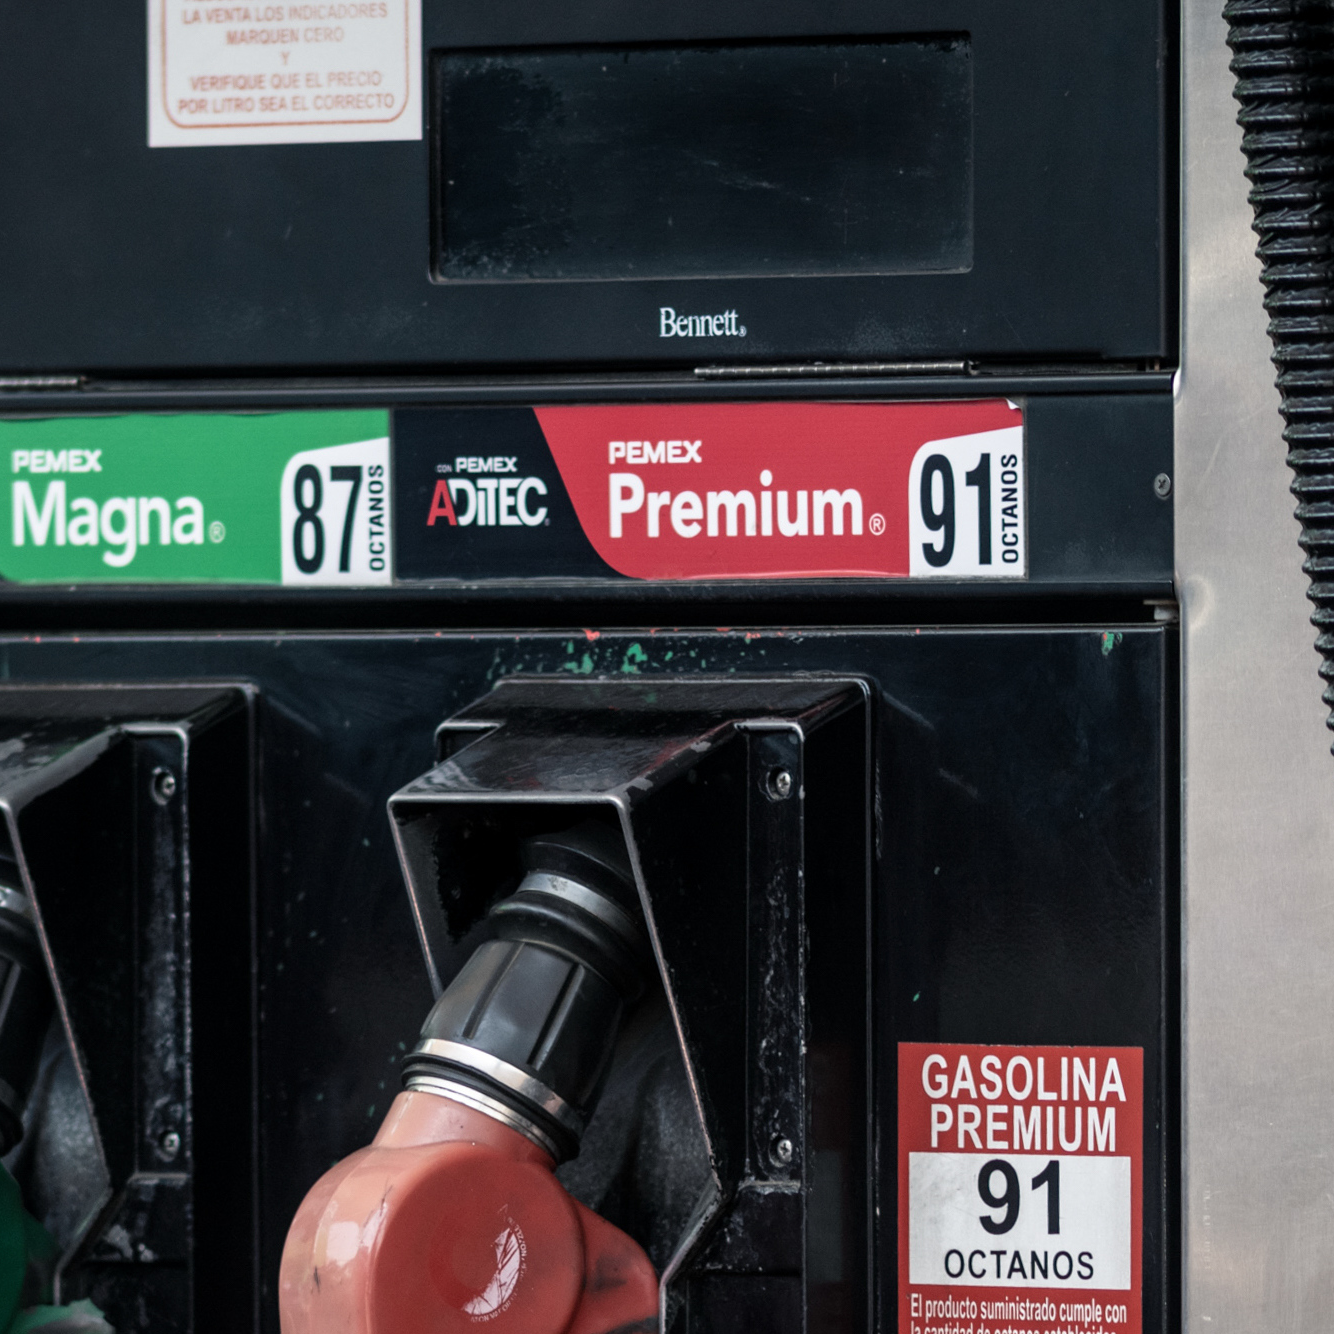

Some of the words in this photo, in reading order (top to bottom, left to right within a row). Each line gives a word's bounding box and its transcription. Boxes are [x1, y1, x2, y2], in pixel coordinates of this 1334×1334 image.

[183, 9, 201, 24] LA
[206, 7, 250, 23] VENTA
[256, 6, 284, 22] LOS
[289, 3, 388, 20] INDICADORES
[226, 28, 299, 45] MARQUEN
[304, 26, 344, 42] CERO
[281, 51, 290, 66] Y
[190, 74, 266, 91] VERIFIQUE
[270, 73, 300, 89] QUE
[305, 72, 322, 88] EL
[327, 70, 382, 87] PRECIO
[178, 98, 208, 114] POR
[212, 97, 255, 113] LITRO
[259, 96, 287, 112] SEA
[292, 95, 309, 111] EL
[313, 93, 395, 111] CORRECTO
[659, 307, 739, 337] Bennett
[11, 449, 103, 474] PEMEX
[455, 457, 517, 473] PEMEX
[608, 440, 702, 464] PEMEX
[293, 464, 364, 574] 87
[368, 464, 385, 572] OCTANOS
[609, 469, 864, 539] Premium
[920, 452, 992, 568] 91
[1001, 454, 1018, 564] OCTANOS
[12, 481, 205, 568] Magna
[922, 1054, 1127, 1102] GASOLINA
[931, 1104, 1116, 1152] PREMIUM
[977, 1159, 1061, 1235] 91
[944, 1249, 1095, 1280] OCTANOS
[911, 1293, 923, 1318] El
[925, 1296, 977, 1324] producto
[980, 1297, 1056, 1322] suministrado
[1059, 1300, 1102, 1329] cumple
[1105, 1304, 1127, 1324] con
